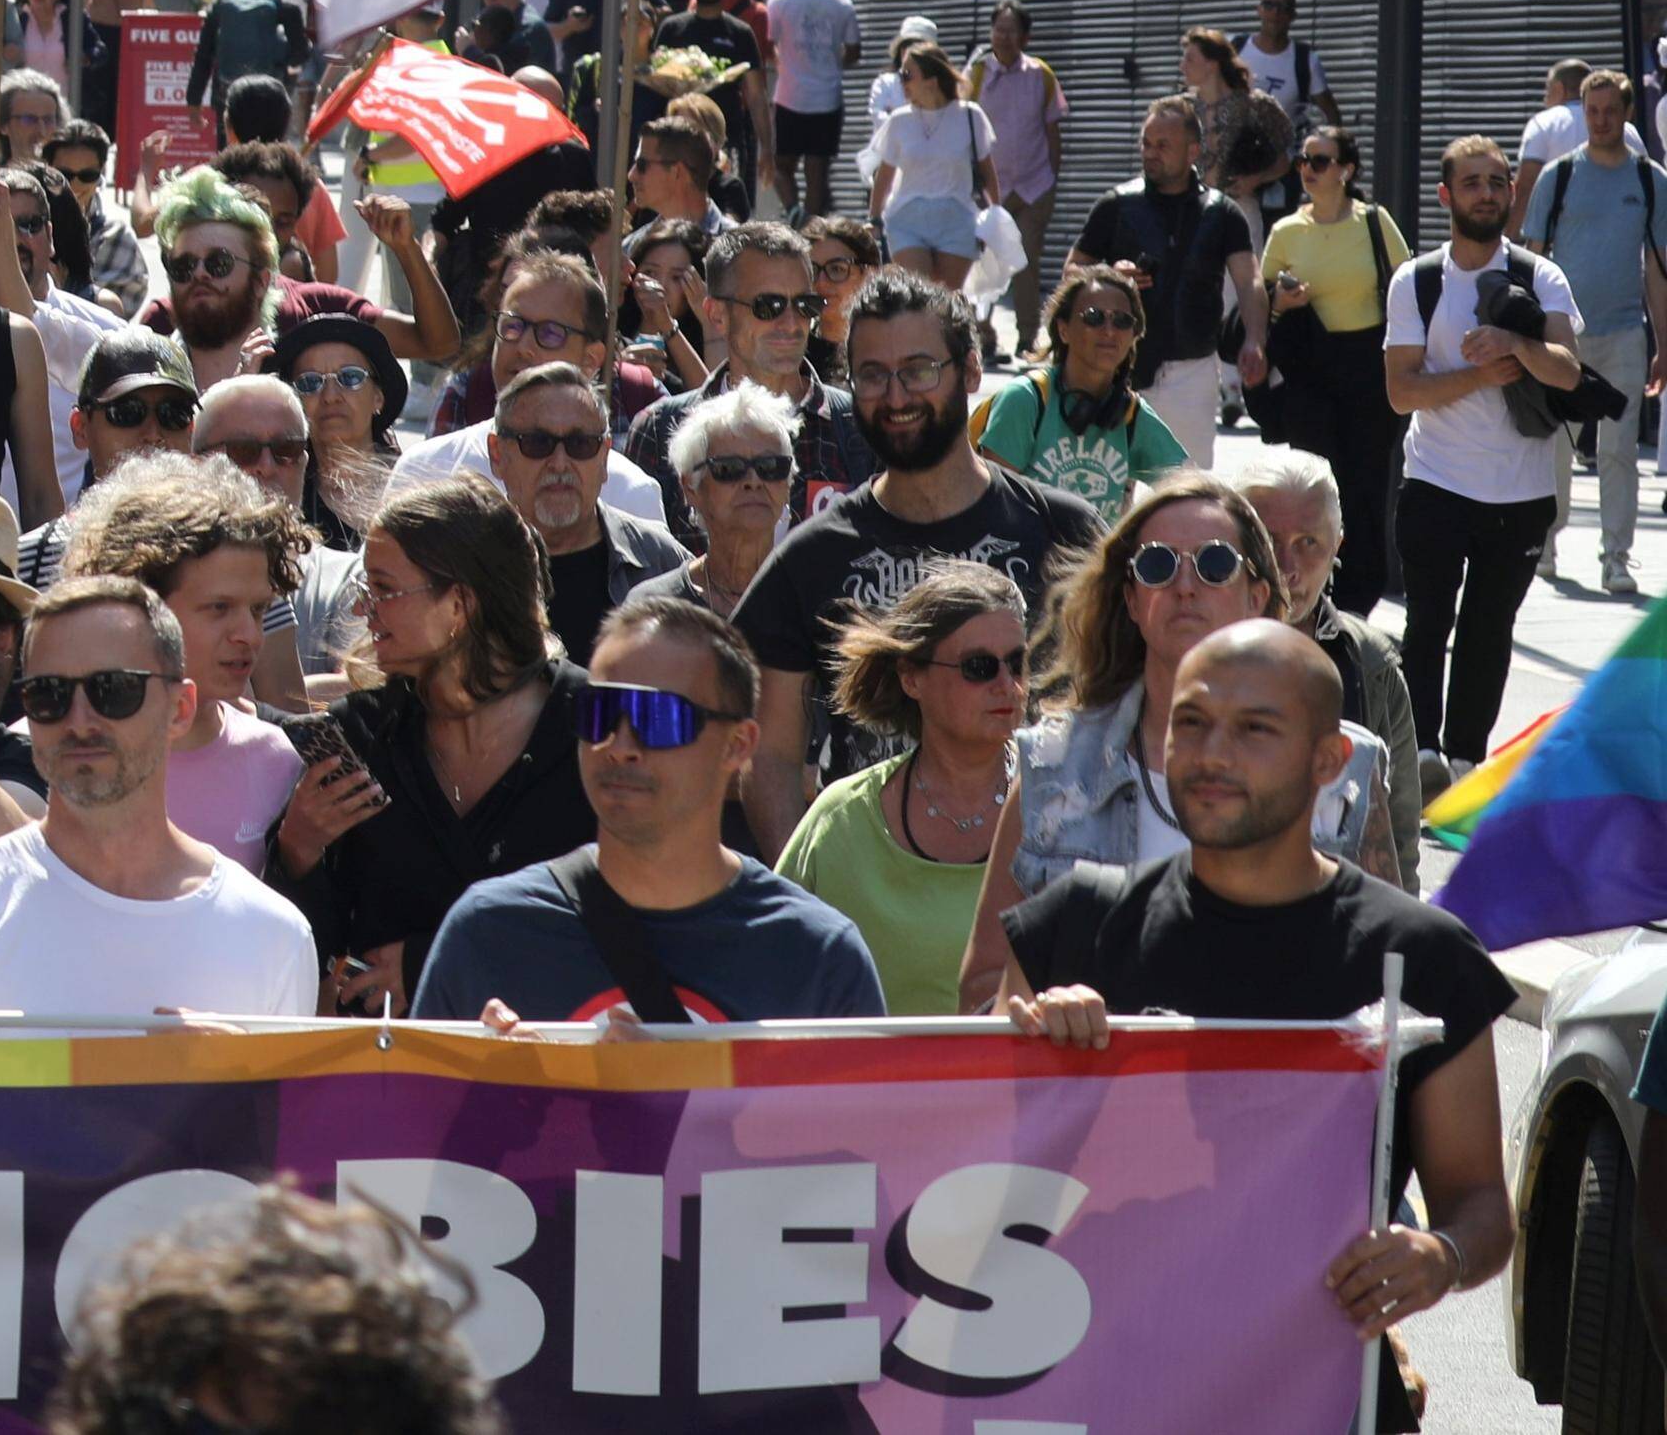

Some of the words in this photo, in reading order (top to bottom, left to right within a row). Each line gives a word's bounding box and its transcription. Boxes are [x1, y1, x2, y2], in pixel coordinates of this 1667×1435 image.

[130, 28, 170, 43] FIVE
[174, 29, 201, 44] GU
[1033, 434, 1129, 484] IRELAND
